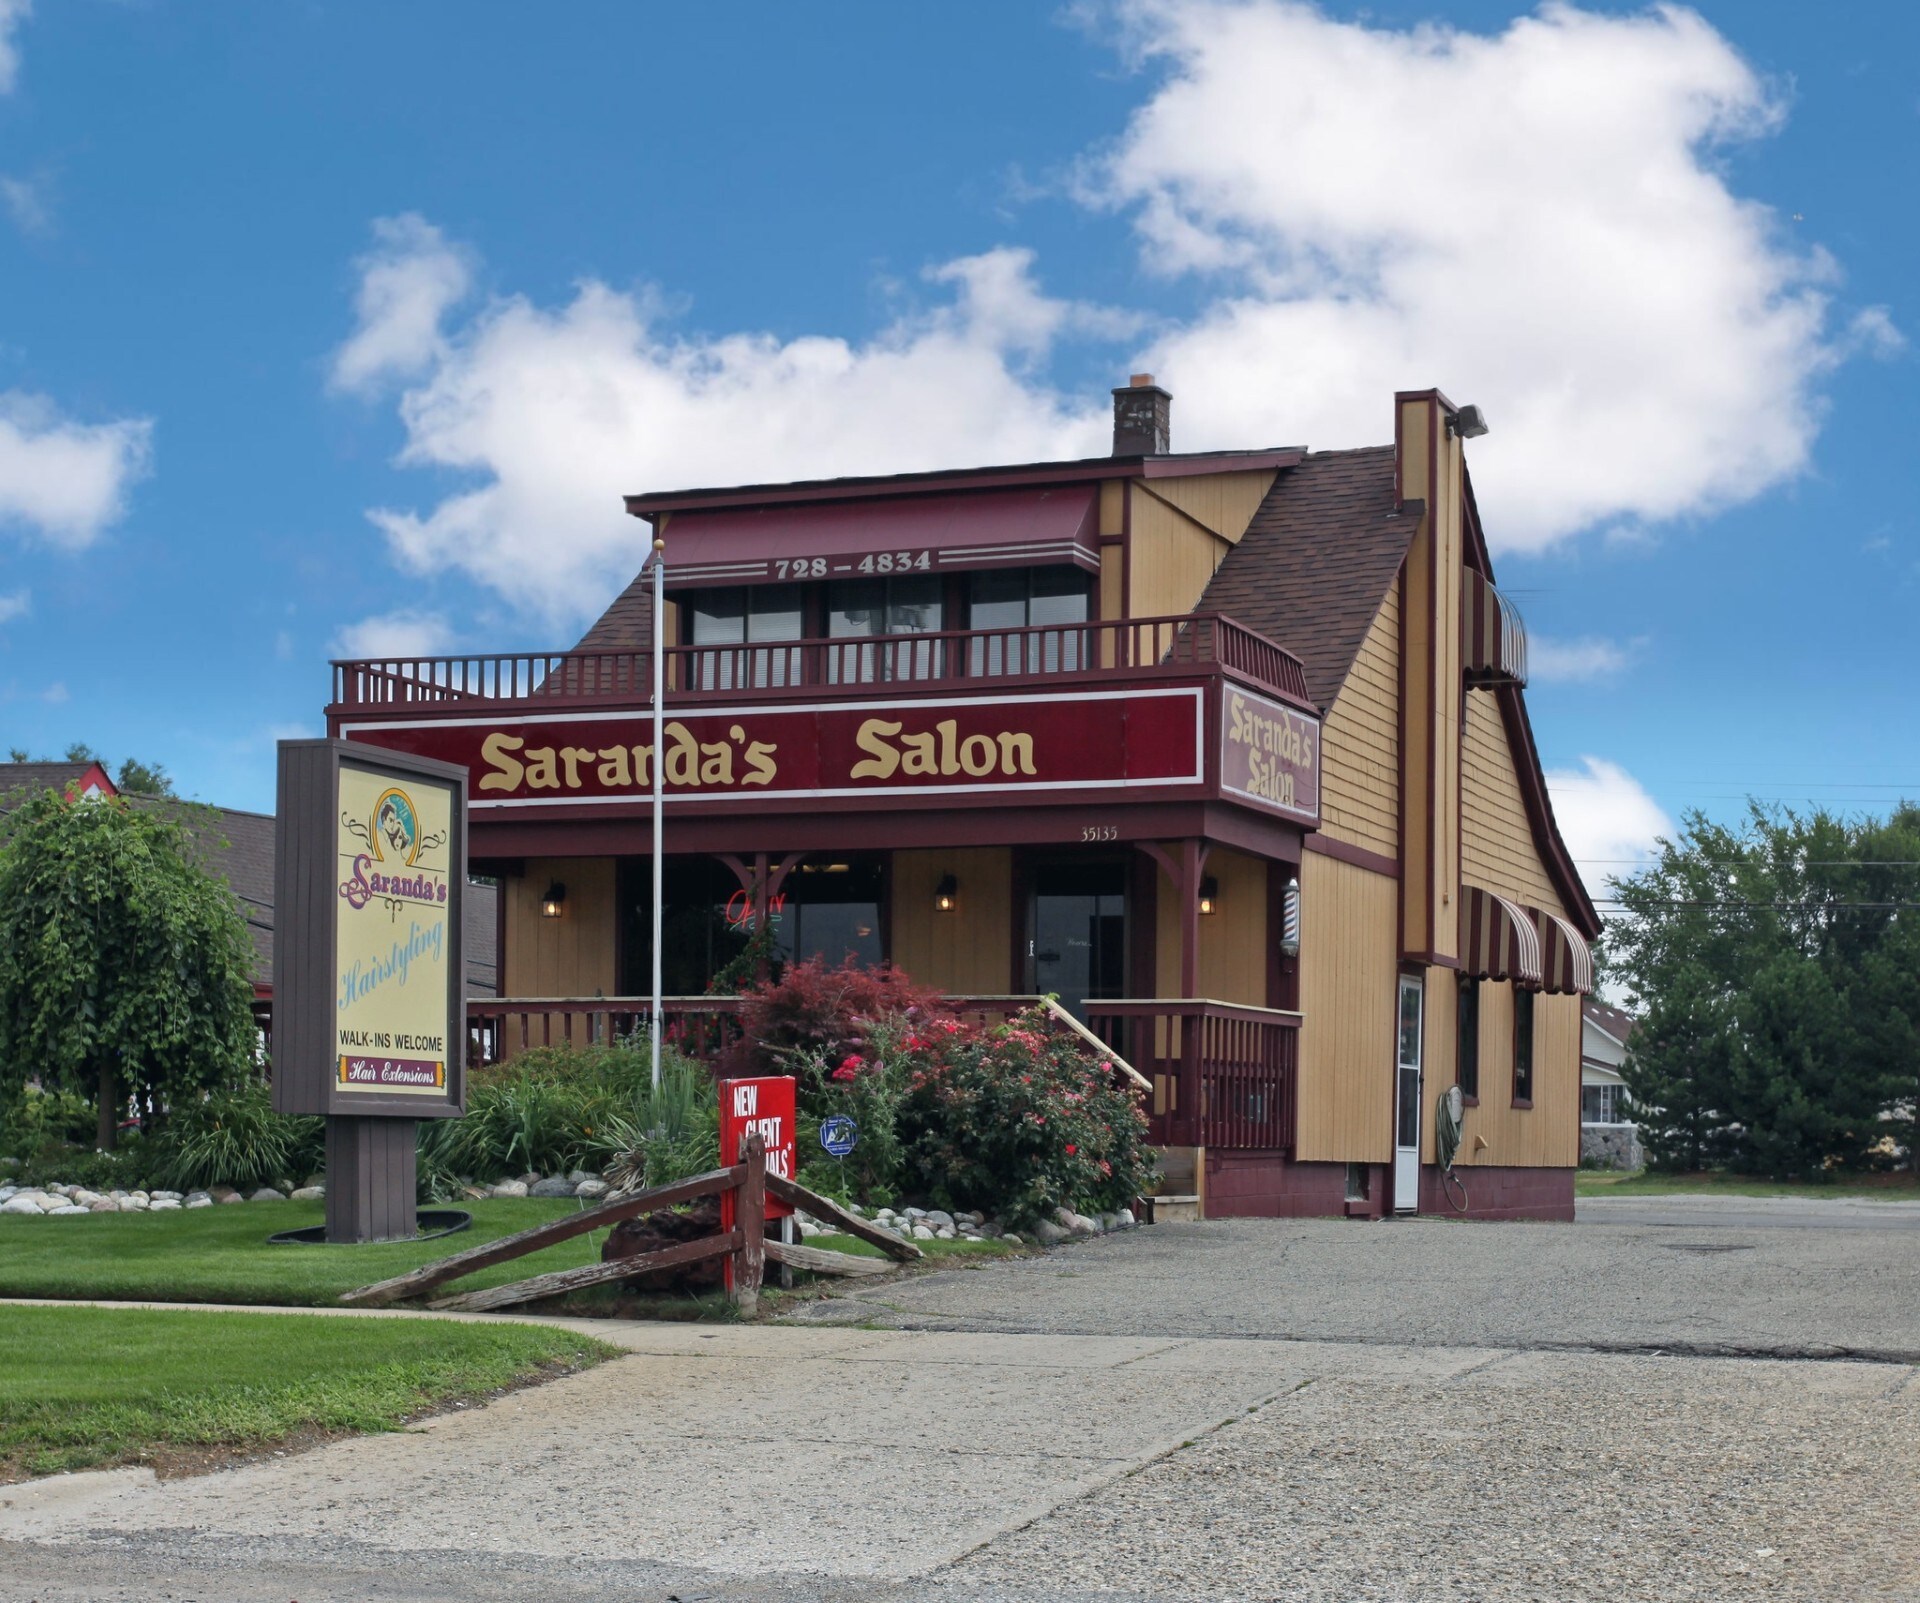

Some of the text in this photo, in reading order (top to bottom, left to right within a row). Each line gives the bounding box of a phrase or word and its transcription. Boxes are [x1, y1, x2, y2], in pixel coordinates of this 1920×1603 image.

[479, 718, 1037, 792] Saranda's Salon
[1229, 693, 1312, 768] Saranda's
[1246, 747, 1295, 807] Salon
[1080, 825, 1118, 842] 35135
[339, 853, 447, 910] Saranda's
[338, 921, 443, 1011] Hairstyling
[339, 1030, 443, 1052] WALK-INS WELCOME
[348, 1060, 435, 1083] Hair Extensions
[733, 1085, 758, 1117] NEW
